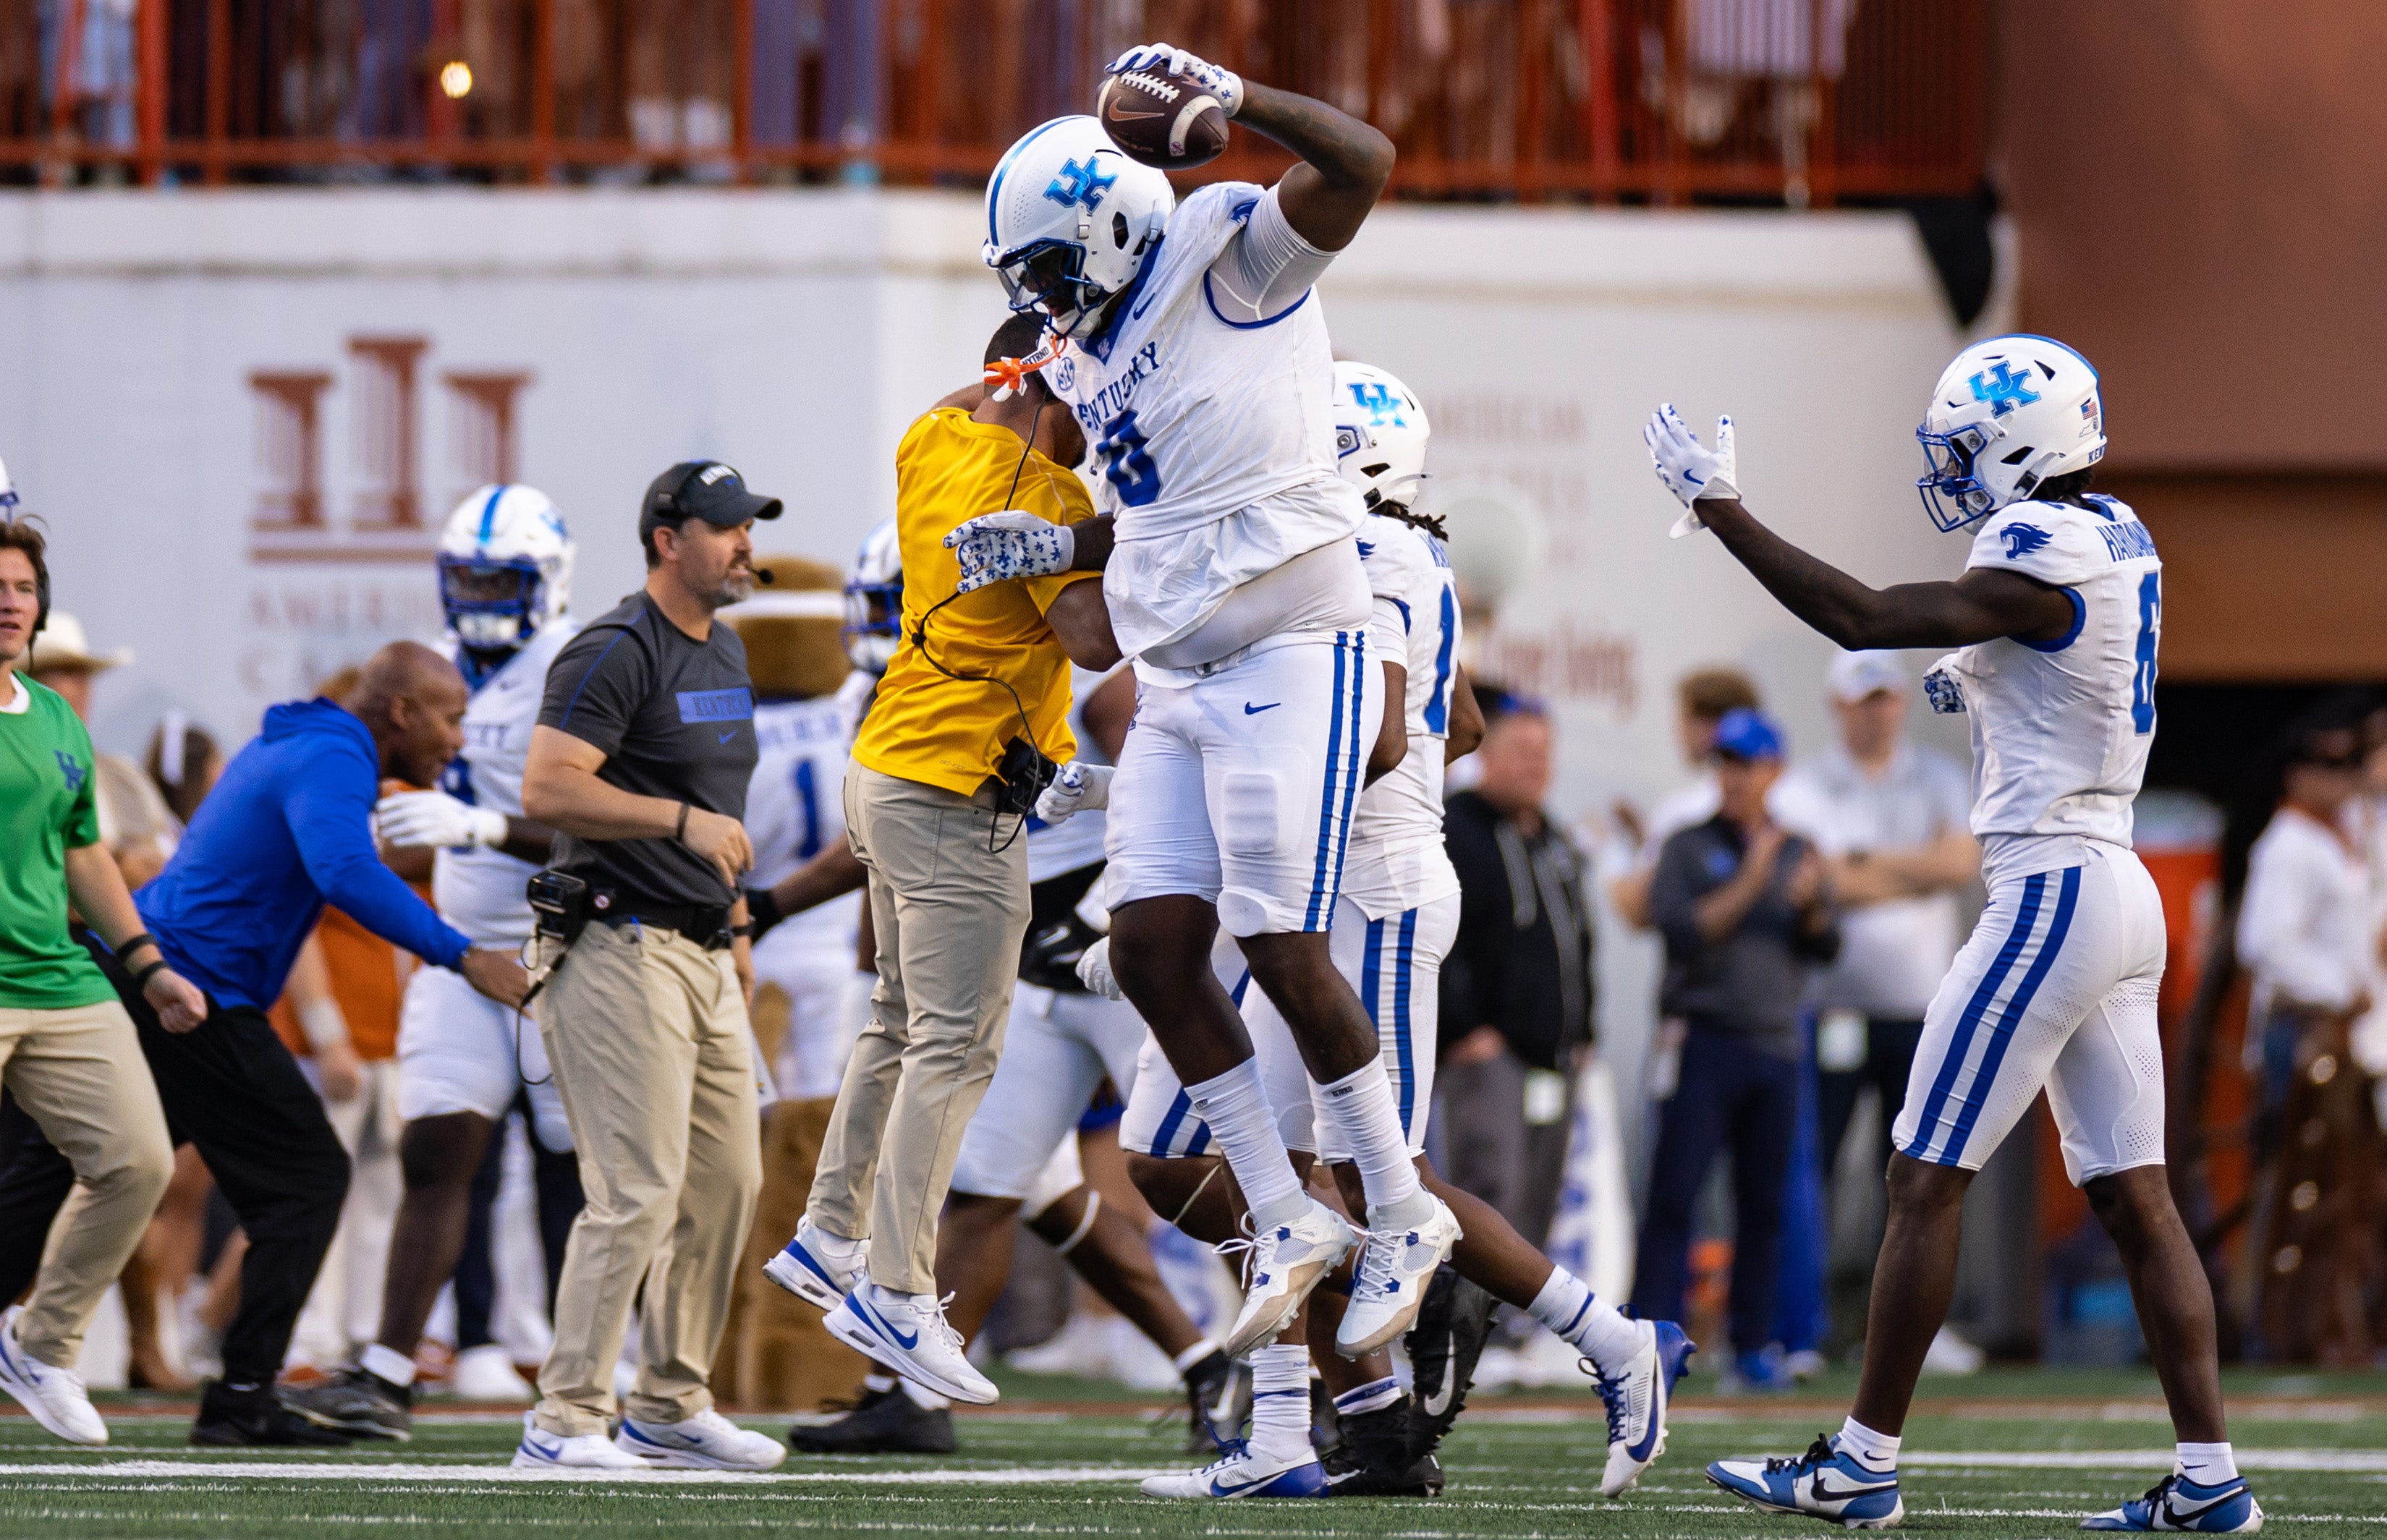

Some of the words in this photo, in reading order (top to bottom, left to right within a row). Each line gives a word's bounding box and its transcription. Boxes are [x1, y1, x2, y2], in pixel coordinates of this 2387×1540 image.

[1043, 156, 1119, 214] UK
[1347, 382, 1407, 429] UK
[1966, 360, 2041, 419] UK
[2132, 569, 2160, 737] 6
